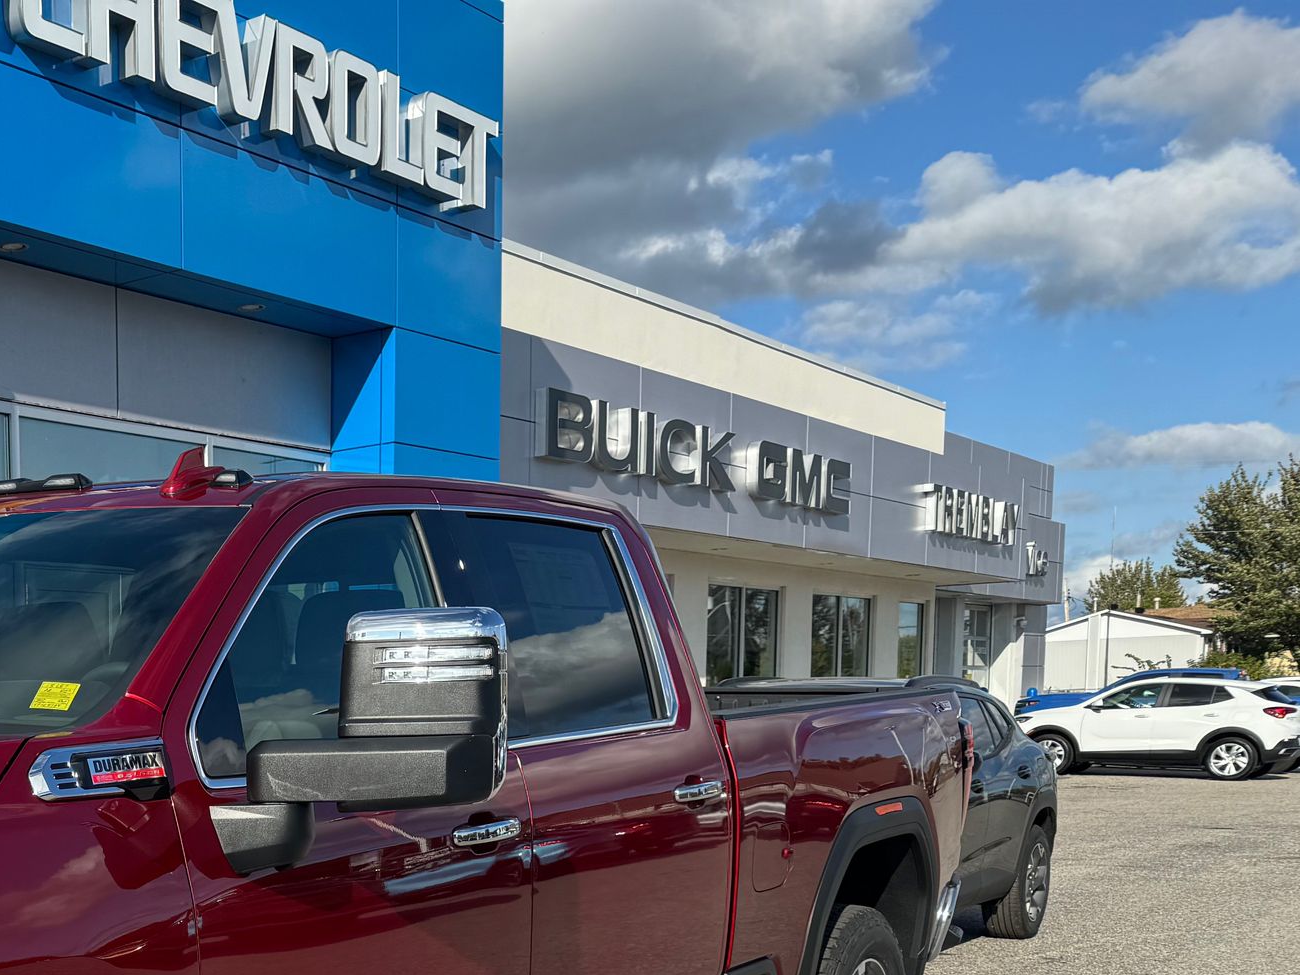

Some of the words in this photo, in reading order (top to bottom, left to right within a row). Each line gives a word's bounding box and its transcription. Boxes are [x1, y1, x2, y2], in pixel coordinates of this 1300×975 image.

[536, 387, 735, 492] BUICK
[747, 440, 852, 515] GMC
[922, 483, 1021, 547] TREMBLAY
[92, 753, 160, 774] DURAMAX
